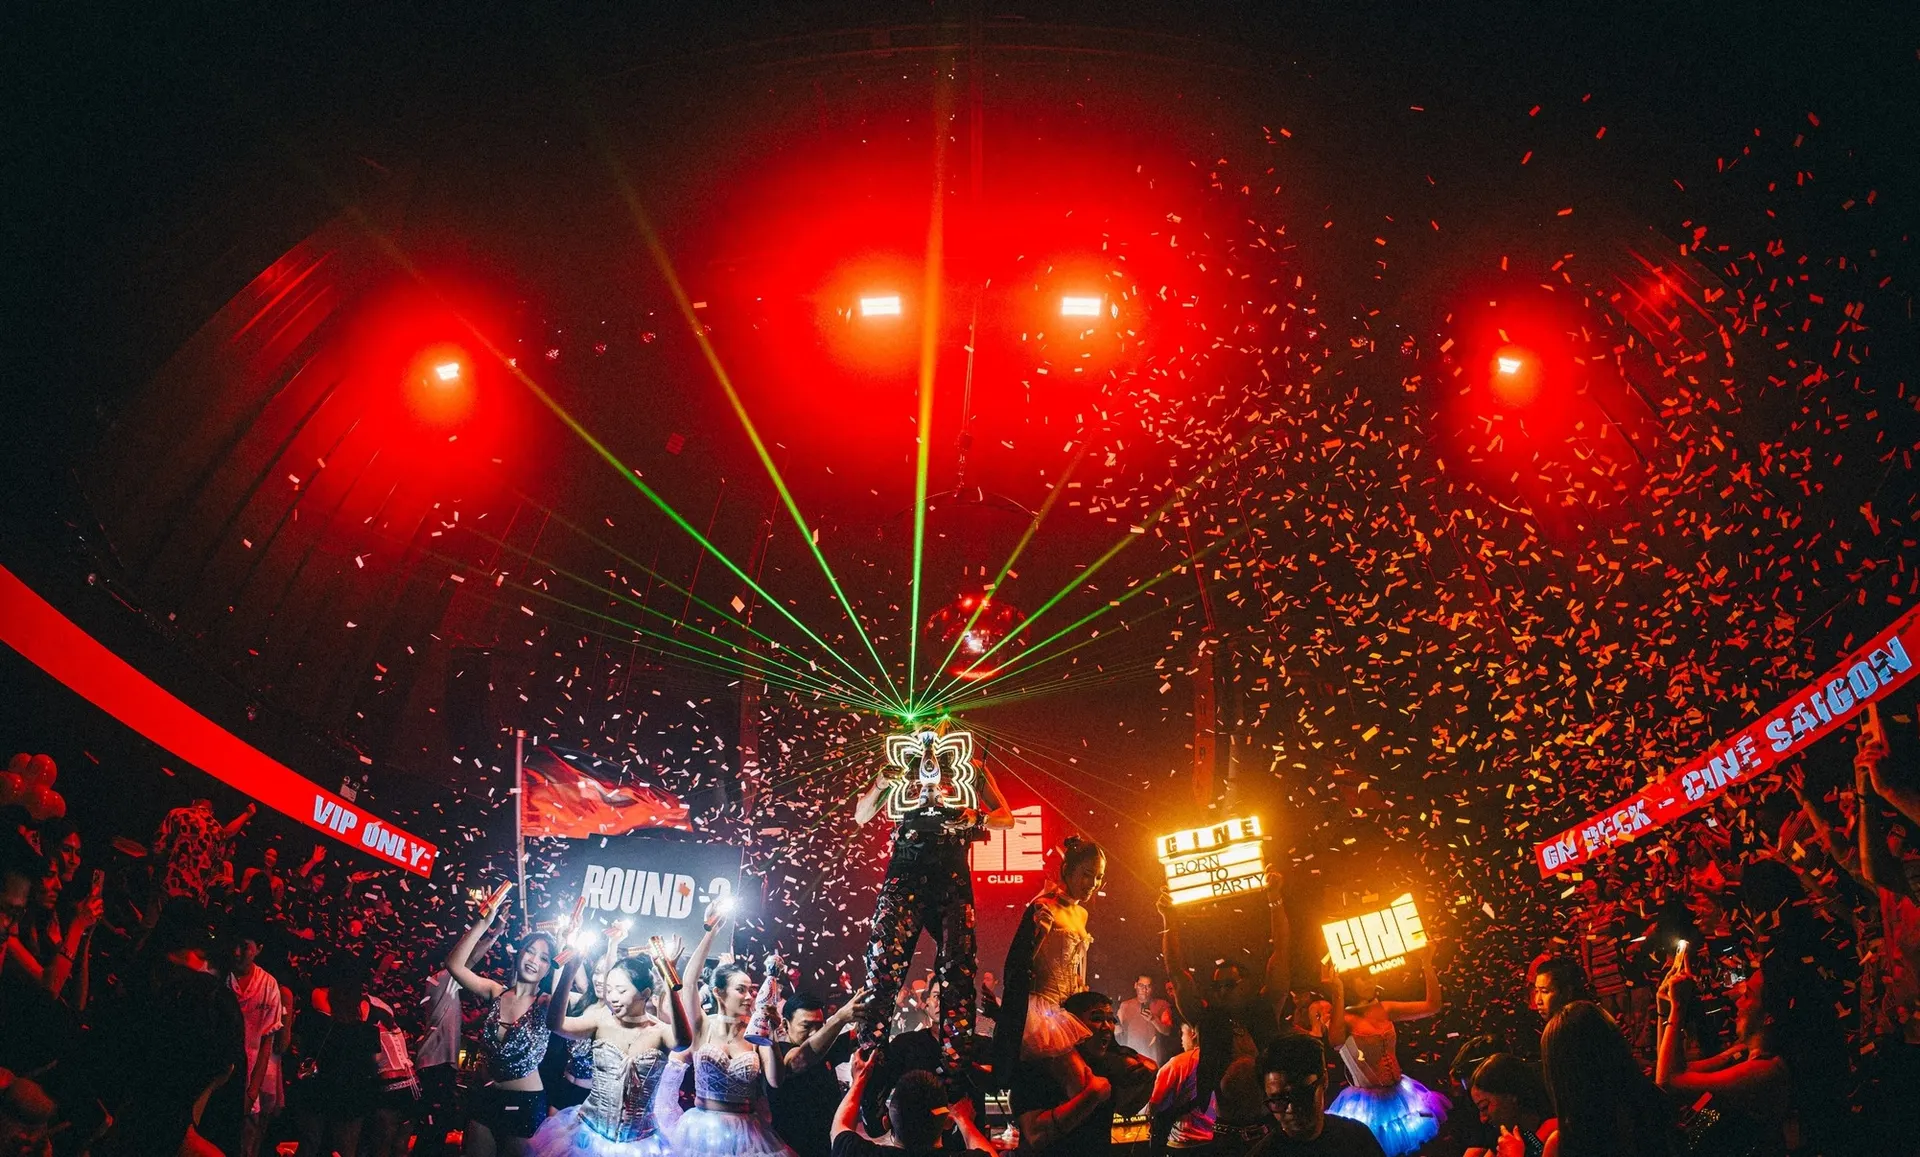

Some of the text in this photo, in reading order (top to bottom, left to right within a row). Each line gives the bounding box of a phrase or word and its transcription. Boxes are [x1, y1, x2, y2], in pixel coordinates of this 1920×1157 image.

[1542, 839, 1579, 870] ON
[1582, 799, 1652, 852] DECK
[1765, 636, 1912, 753] SAIGON
[313, 794, 358, 835] VIP
[1175, 854, 1220, 876] BORN
[1206, 867, 1229, 883] TO
[987, 875, 1024, 884] CLUB
[1212, 873, 1265, 896] PARTY
[581, 865, 696, 919] ROUND
[1369, 955, 1406, 975] SAIGON
